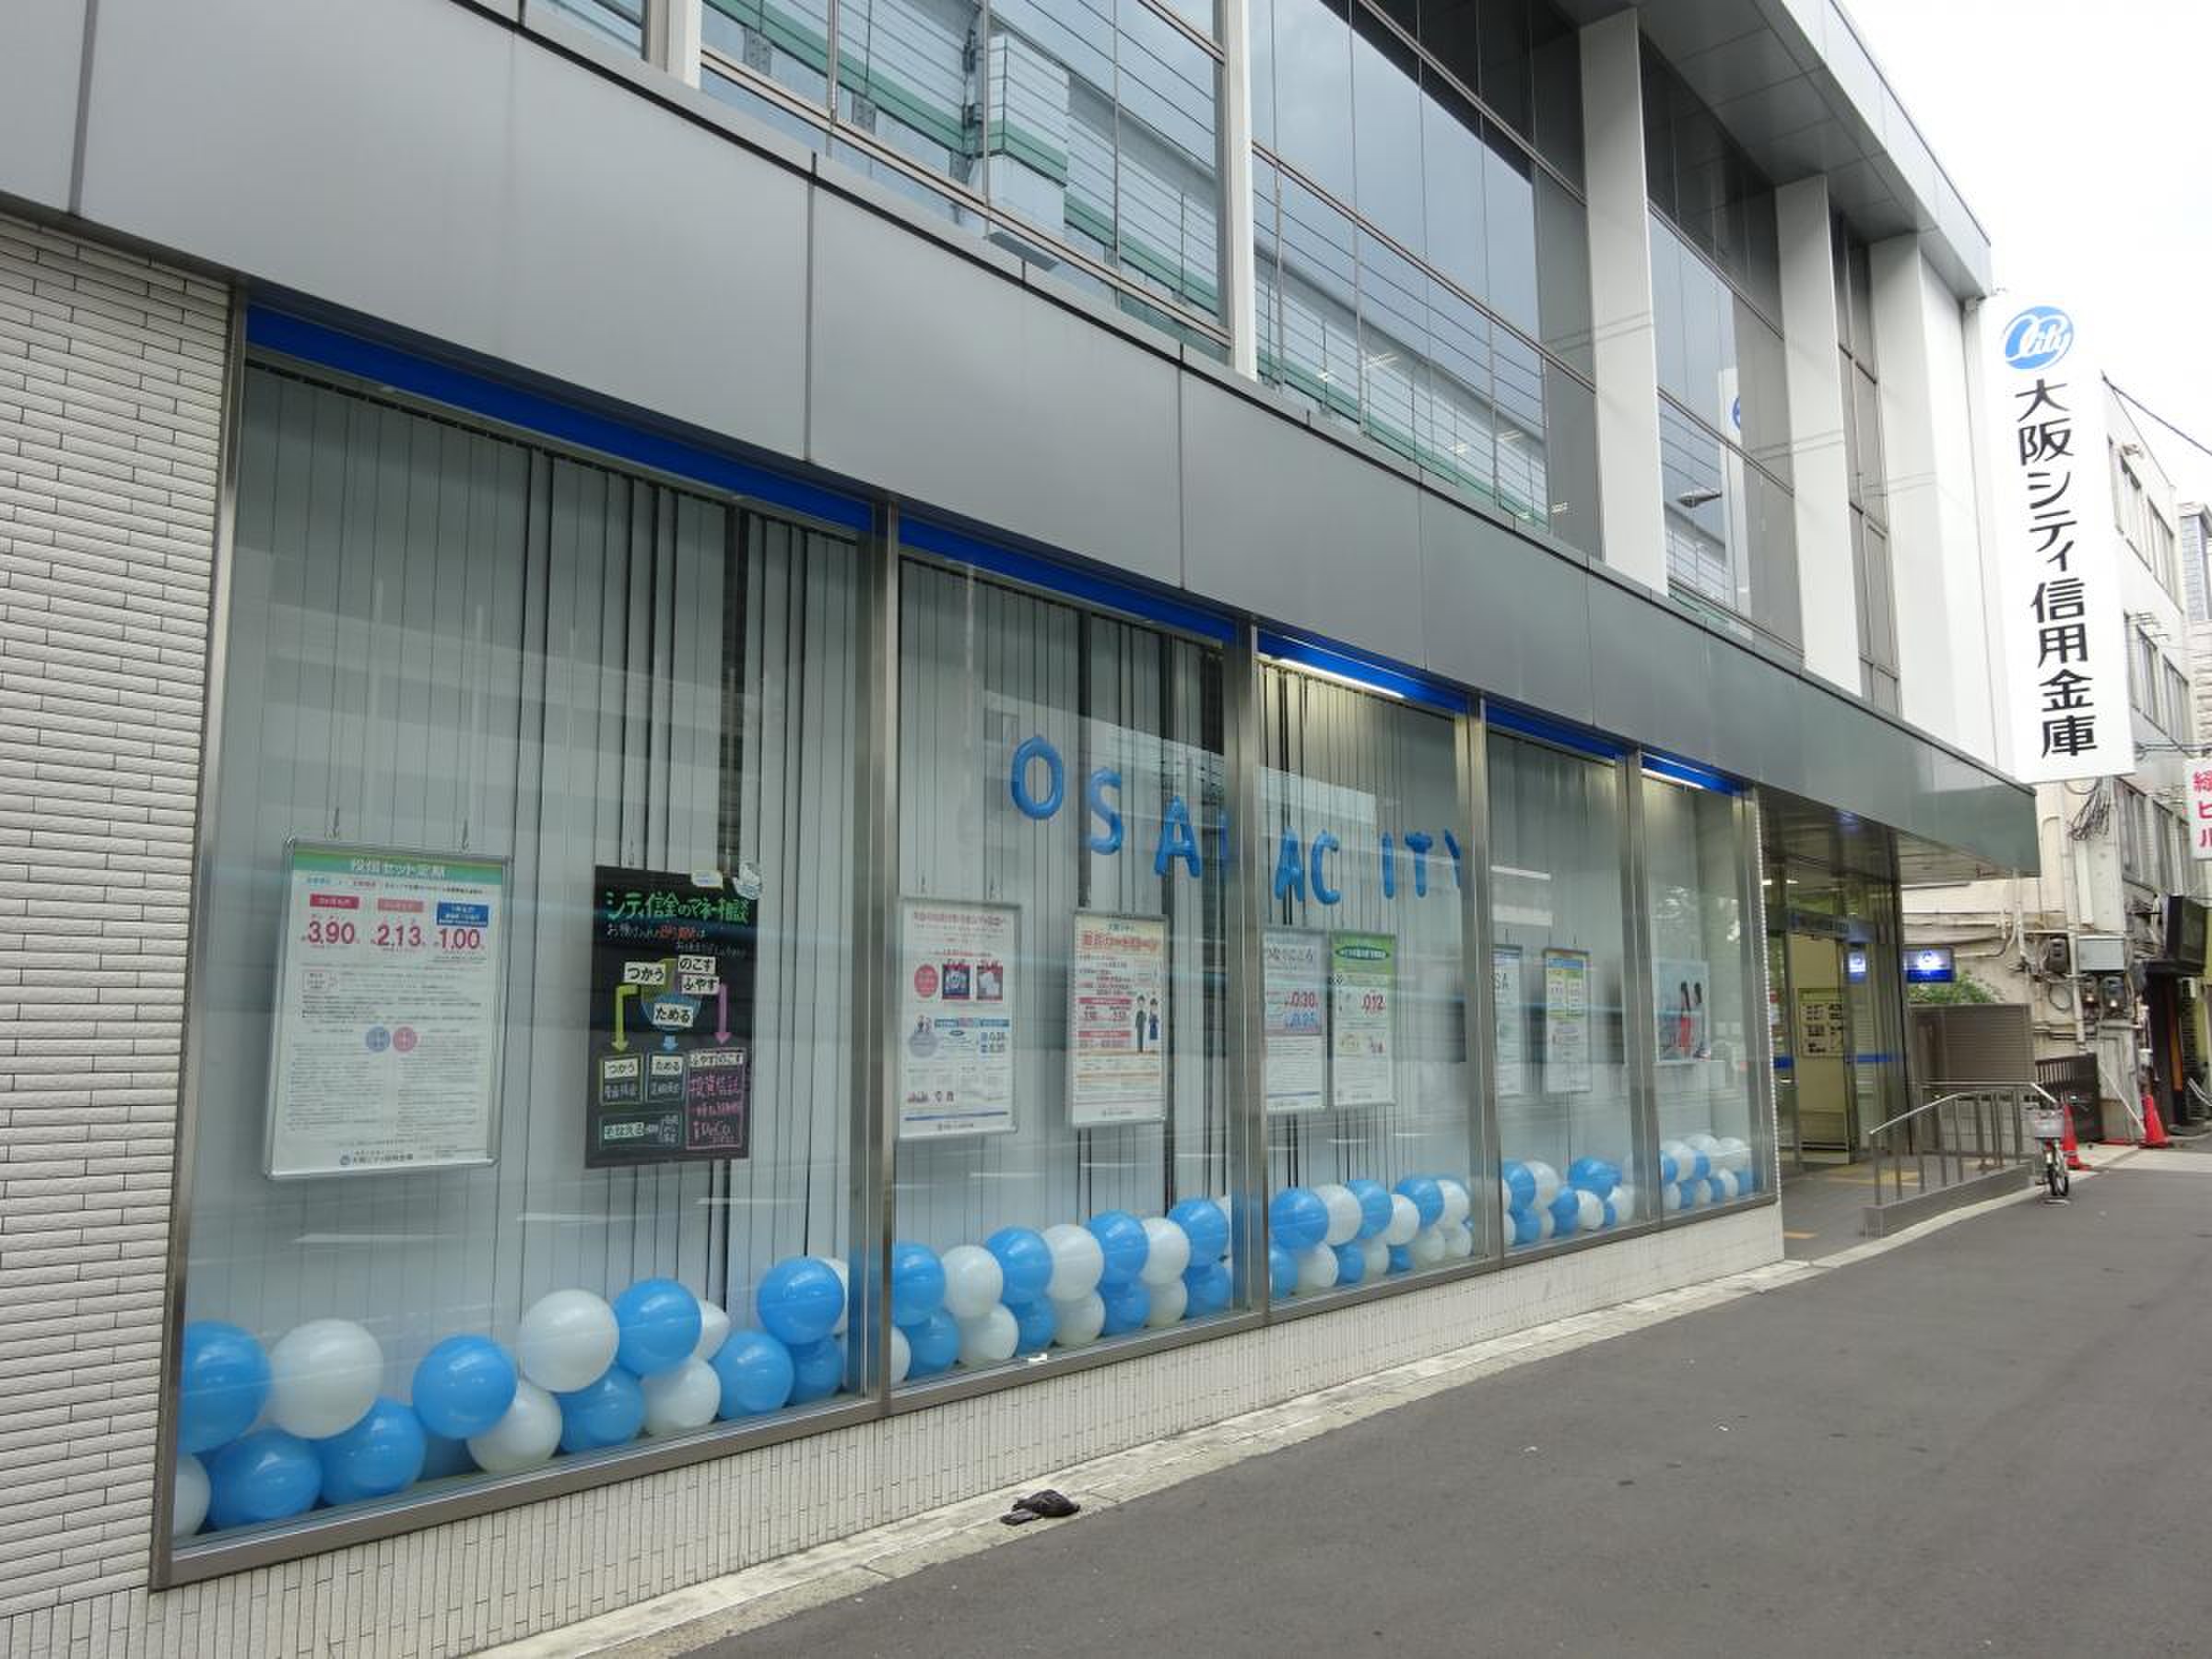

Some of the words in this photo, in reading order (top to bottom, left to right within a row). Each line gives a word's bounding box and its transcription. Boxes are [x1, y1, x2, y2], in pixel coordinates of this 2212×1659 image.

[2015, 379, 2098, 758] 大阪シティ信用金庫
[308, 922, 355, 945] 3.90
[377, 924, 421, 947] 2.13
[440, 928, 480, 949] 1.00
[627, 966, 665, 982] つかう
[679, 957, 713, 971] のこす
[655, 1005, 690, 1024] ためる
